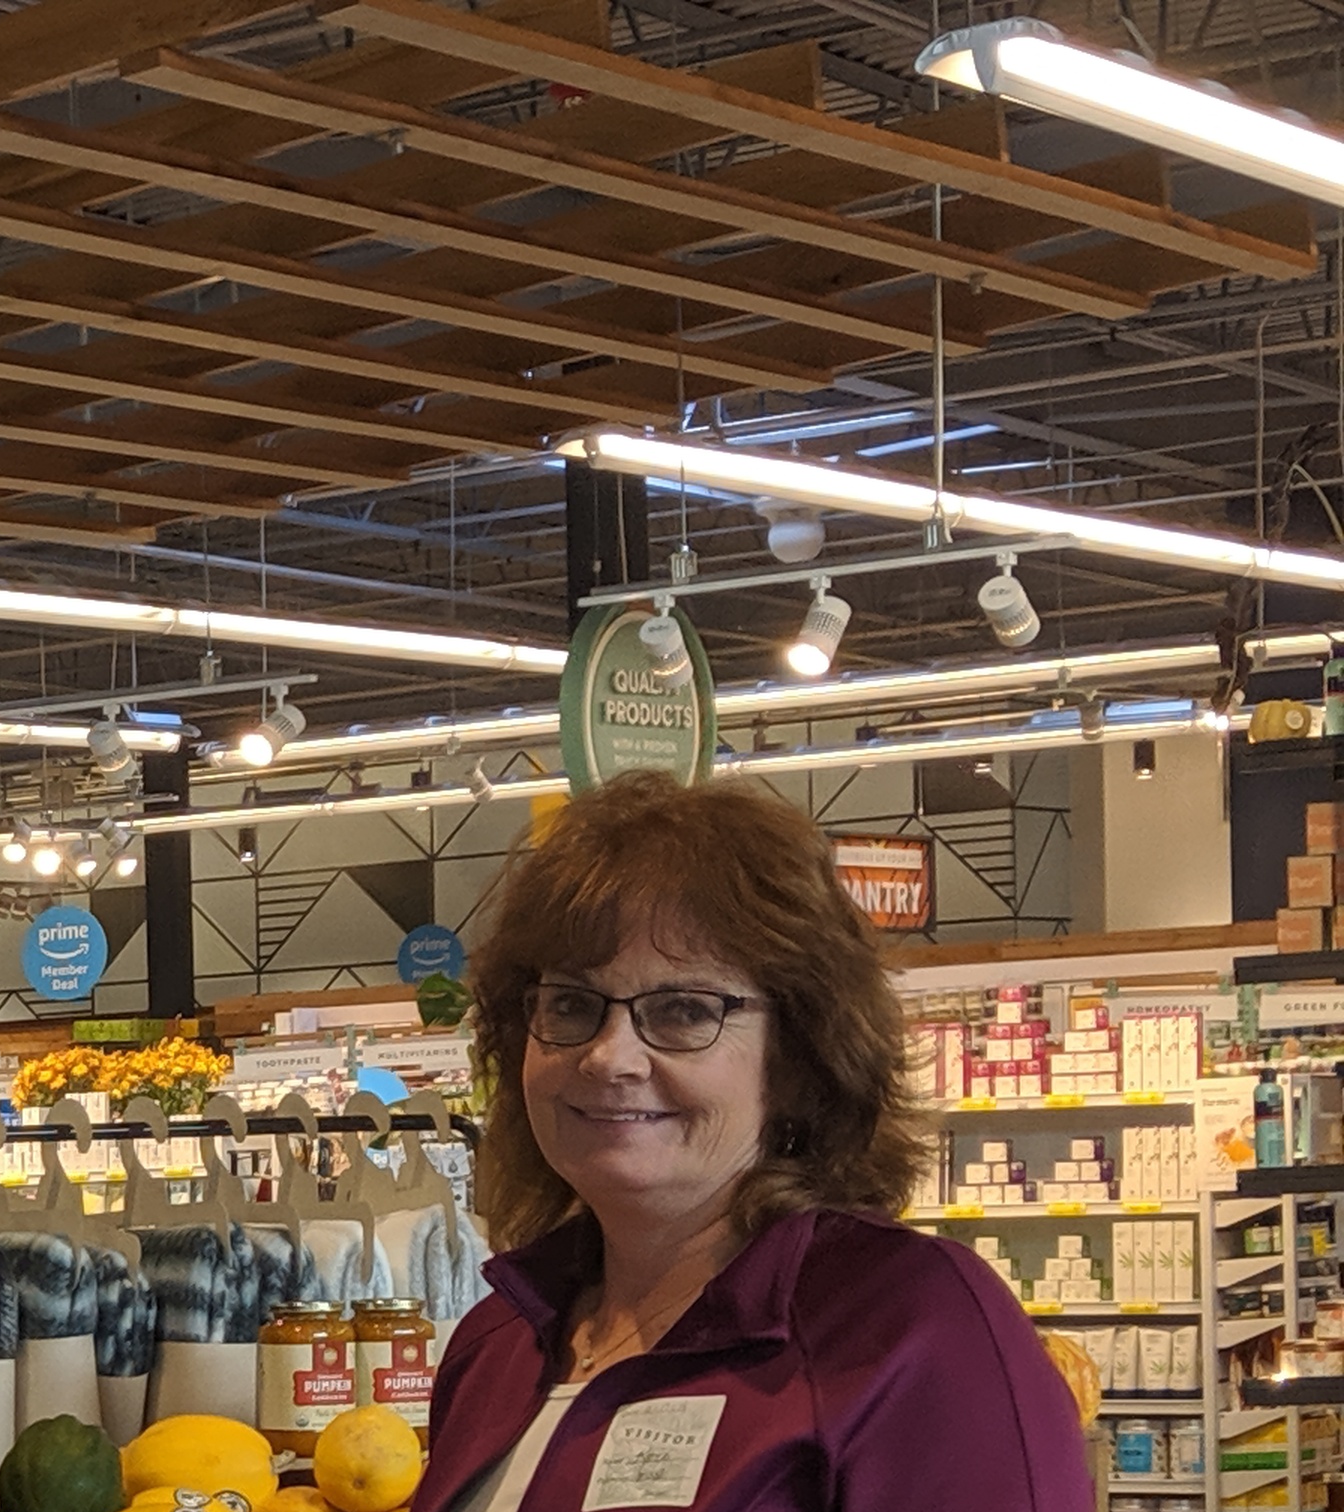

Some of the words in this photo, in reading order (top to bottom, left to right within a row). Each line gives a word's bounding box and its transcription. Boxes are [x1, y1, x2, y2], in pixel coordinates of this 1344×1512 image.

[614, 669, 687, 696] QUAL
[605, 700, 692, 728] PRODUCTS
[841, 879, 923, 914] ANTRY
[38, 922, 89, 946] prime
[410, 935, 451, 955] prime
[41, 964, 89, 978] Member
[51, 977, 78, 990] Deal
[1284, 1002, 1327, 1012] GREEN
[256, 1056, 321, 1068] TOOTHPASTE
[304, 1379, 352, 1393] PUMPKIN
[384, 1377, 432, 1390] PUMPKIN
[624, 1428, 697, 1446] VISITOR
